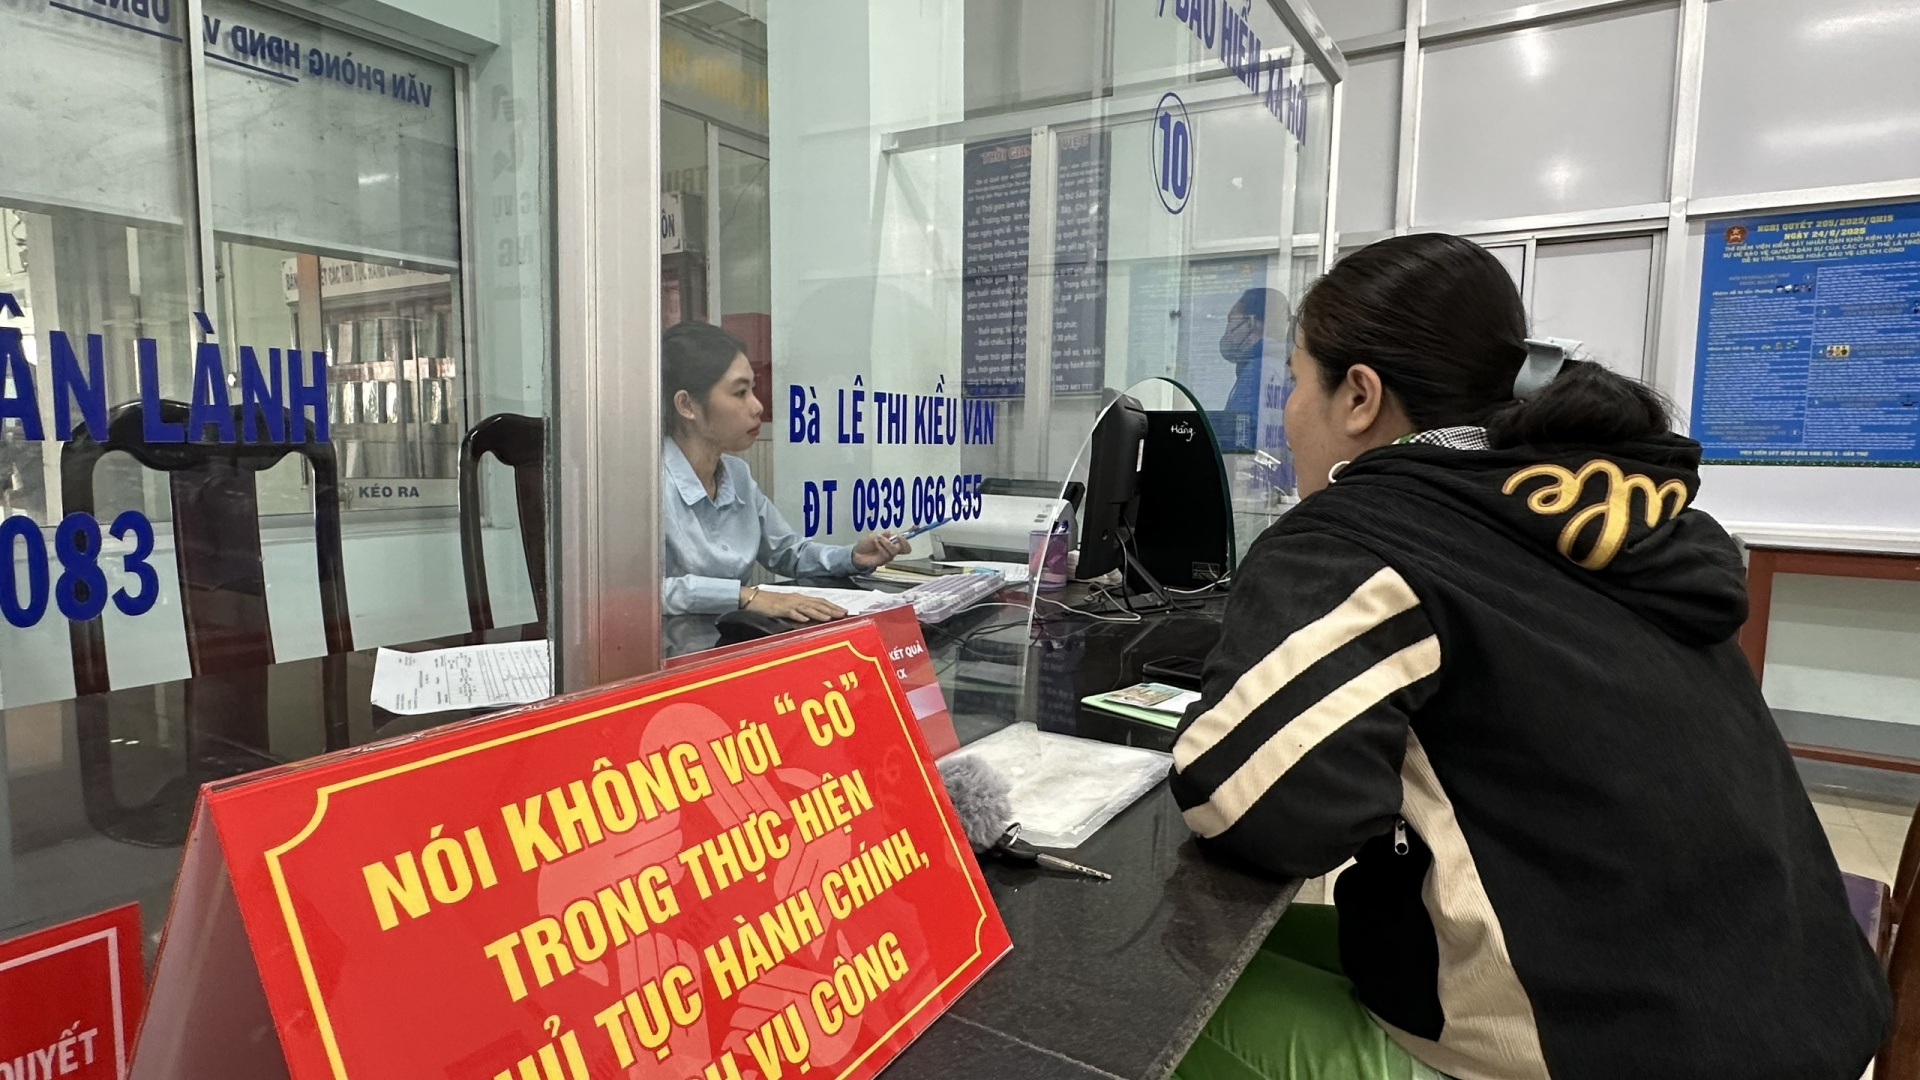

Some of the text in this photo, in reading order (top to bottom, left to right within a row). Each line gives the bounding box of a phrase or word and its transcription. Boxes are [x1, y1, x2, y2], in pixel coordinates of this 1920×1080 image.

[1159, 111, 1189, 200] 10
[1757, 214, 1894, 232] NGHỊ QUYẾT 205/2025/QH15
[1784, 231, 1810, 240] NGÀY
[140, 312, 329, 444] LÀNH
[789, 385, 821, 444] Bà
[838, 375, 865, 444] LÊ
[914, 374, 958, 445] KIỀU
[359, 483, 420, 498] KÉO RA
[803, 474, 983, 538] ĐT 0939 066 855
[0, 511, 160, 628] 083
[362, 824, 498, 931] NÓI
[500, 743, 713, 872] KHÔNG
[709, 719, 782, 785] VỚI
[483, 768, 874, 1002] TRONG THỰC HIỆN
[593, 965, 702, 1069] TỤC
[703, 888, 824, 1005] HÀNH
[821, 828, 930, 920] CHÍNH,
[745, 932, 910, 1080] VỤ CÔNG
